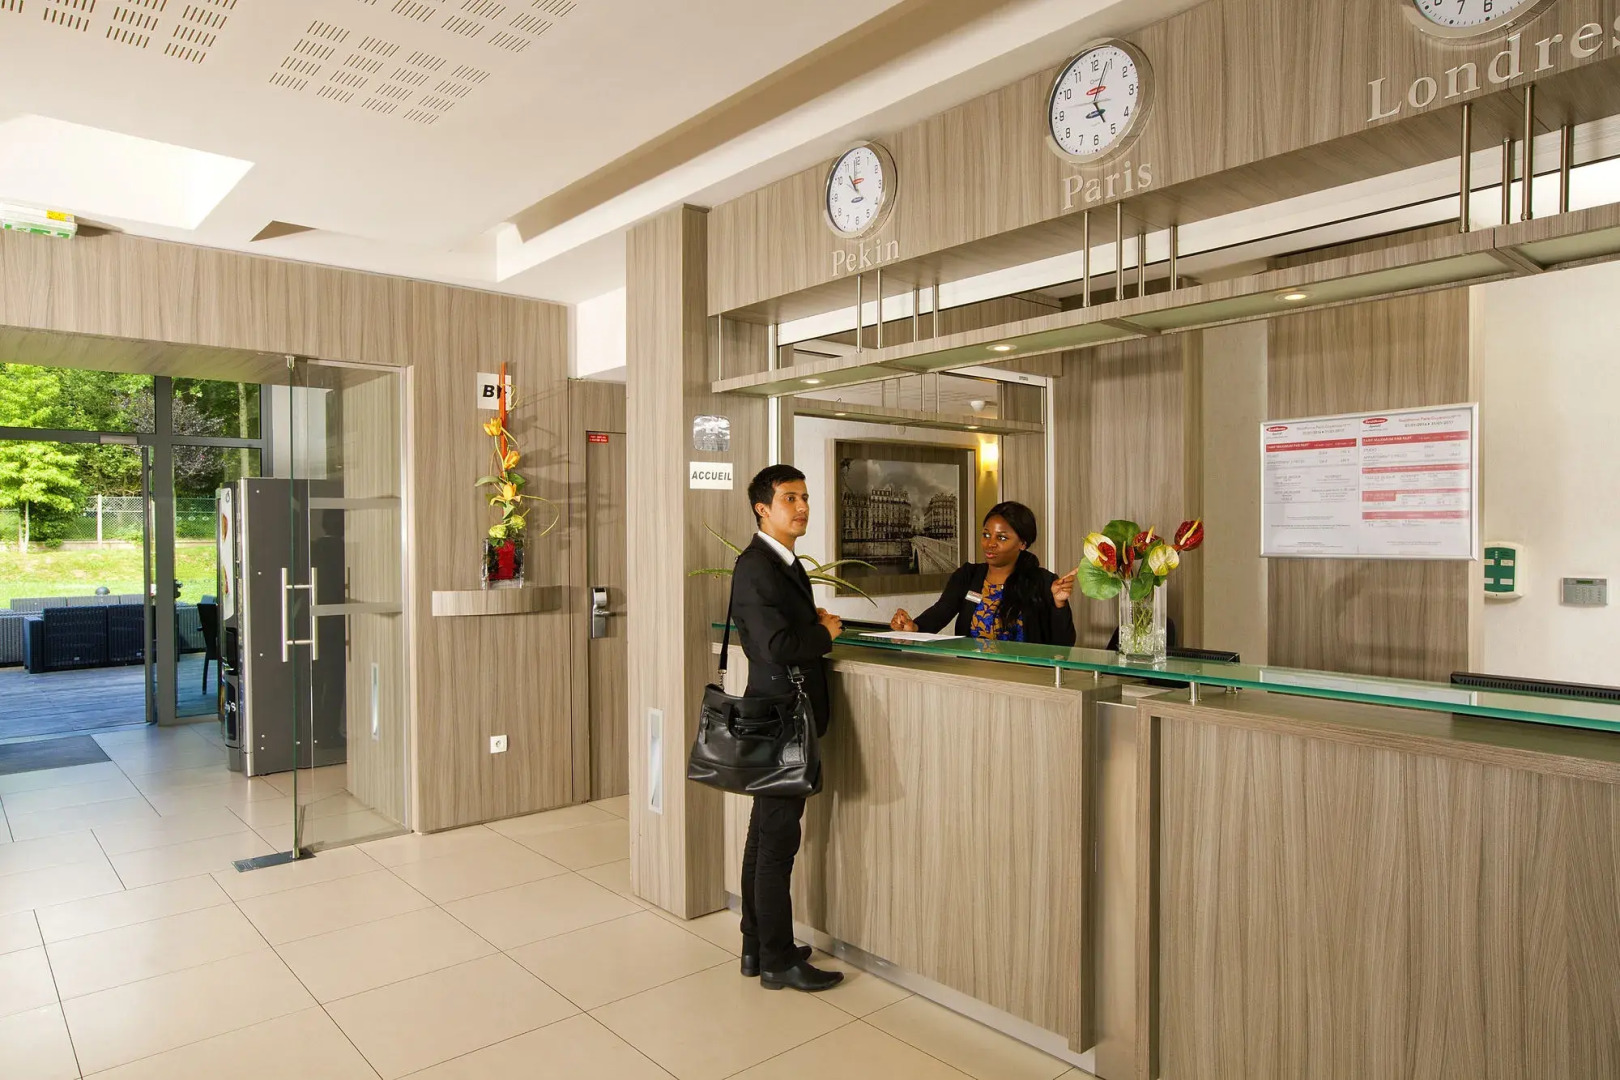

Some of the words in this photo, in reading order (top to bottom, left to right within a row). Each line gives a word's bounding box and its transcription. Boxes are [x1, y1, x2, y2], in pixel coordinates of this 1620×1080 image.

[1090, 59, 1100, 72] 12
[1074, 71, 1082, 84] 11
[1122, 66, 1128, 78] 2
[1063, 88, 1072, 101] 10
[1128, 84, 1135, 96] 3
[1059, 110, 1065, 122] 9
[1123, 106, 1129, 118] 4
[1065, 127, 1071, 139] 8
[1110, 123, 1116, 135] 5
[1078, 134, 1084, 146] 7
[1093, 134, 1099, 146] 6
[1061, 160, 1153, 211] Paris
[831, 238, 900, 277] Pekin
[483, 384, 495, 398] B
[691, 471, 732, 481] ACCUEIL
